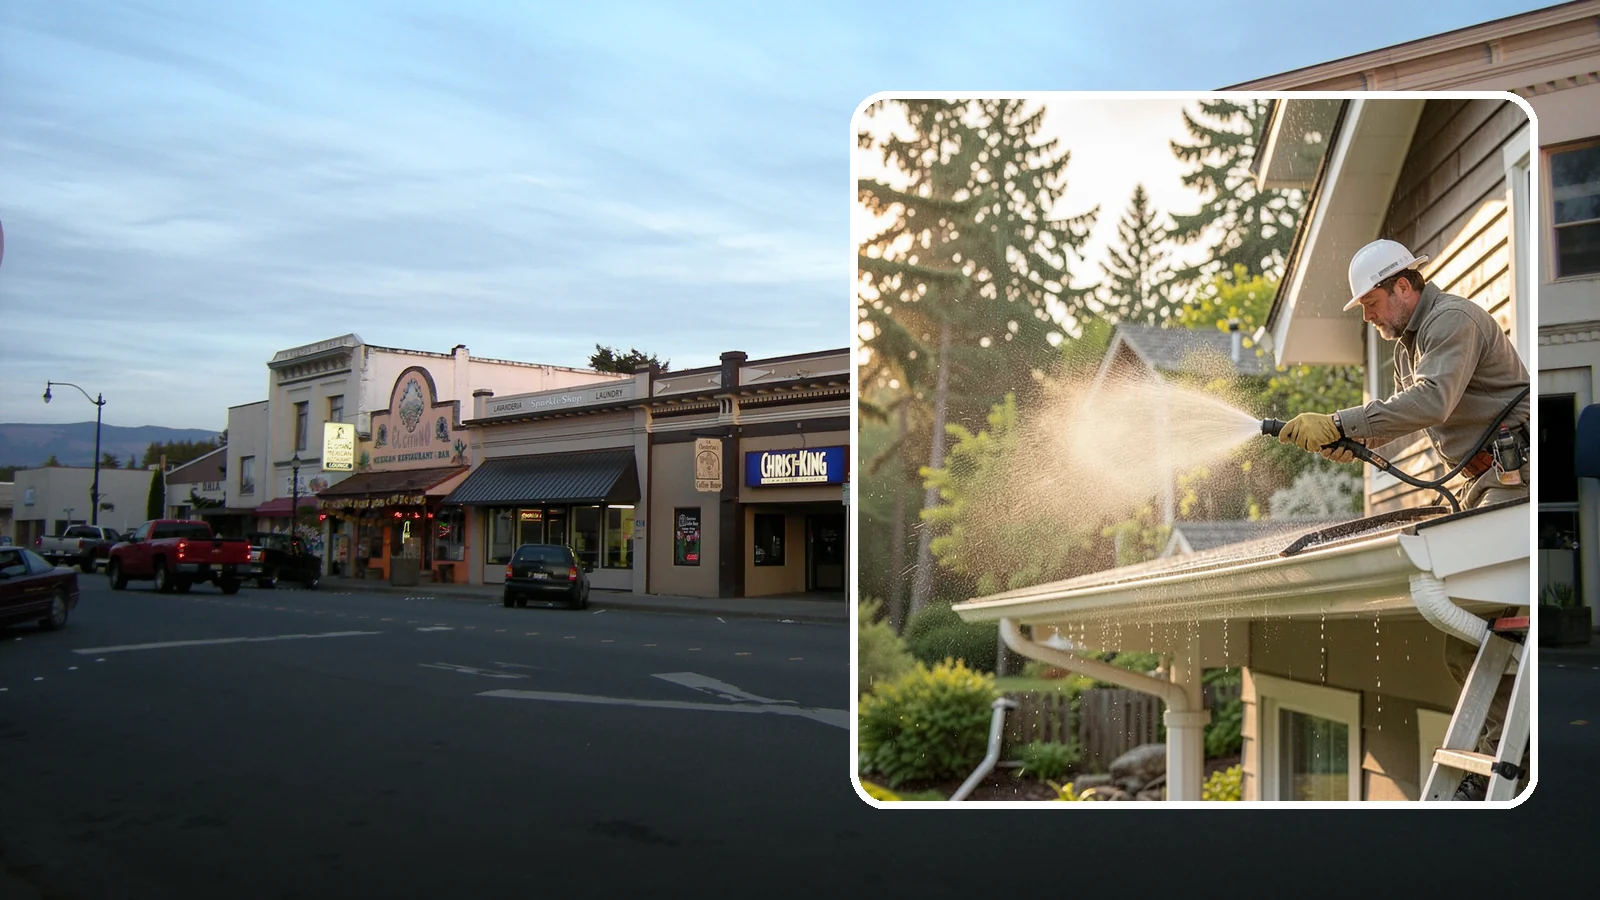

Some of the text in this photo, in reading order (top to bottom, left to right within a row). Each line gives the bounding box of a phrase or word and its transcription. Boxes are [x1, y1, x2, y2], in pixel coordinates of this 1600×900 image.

[561, 394, 582, 406] Shop
[595, 388, 623, 400] LAUNDRY
[493, 402, 522, 412] LAVANDERIA
[374, 450, 450, 464] MEXICAN RESTAURANT BAR
[696, 480, 722, 488] Coffee House
